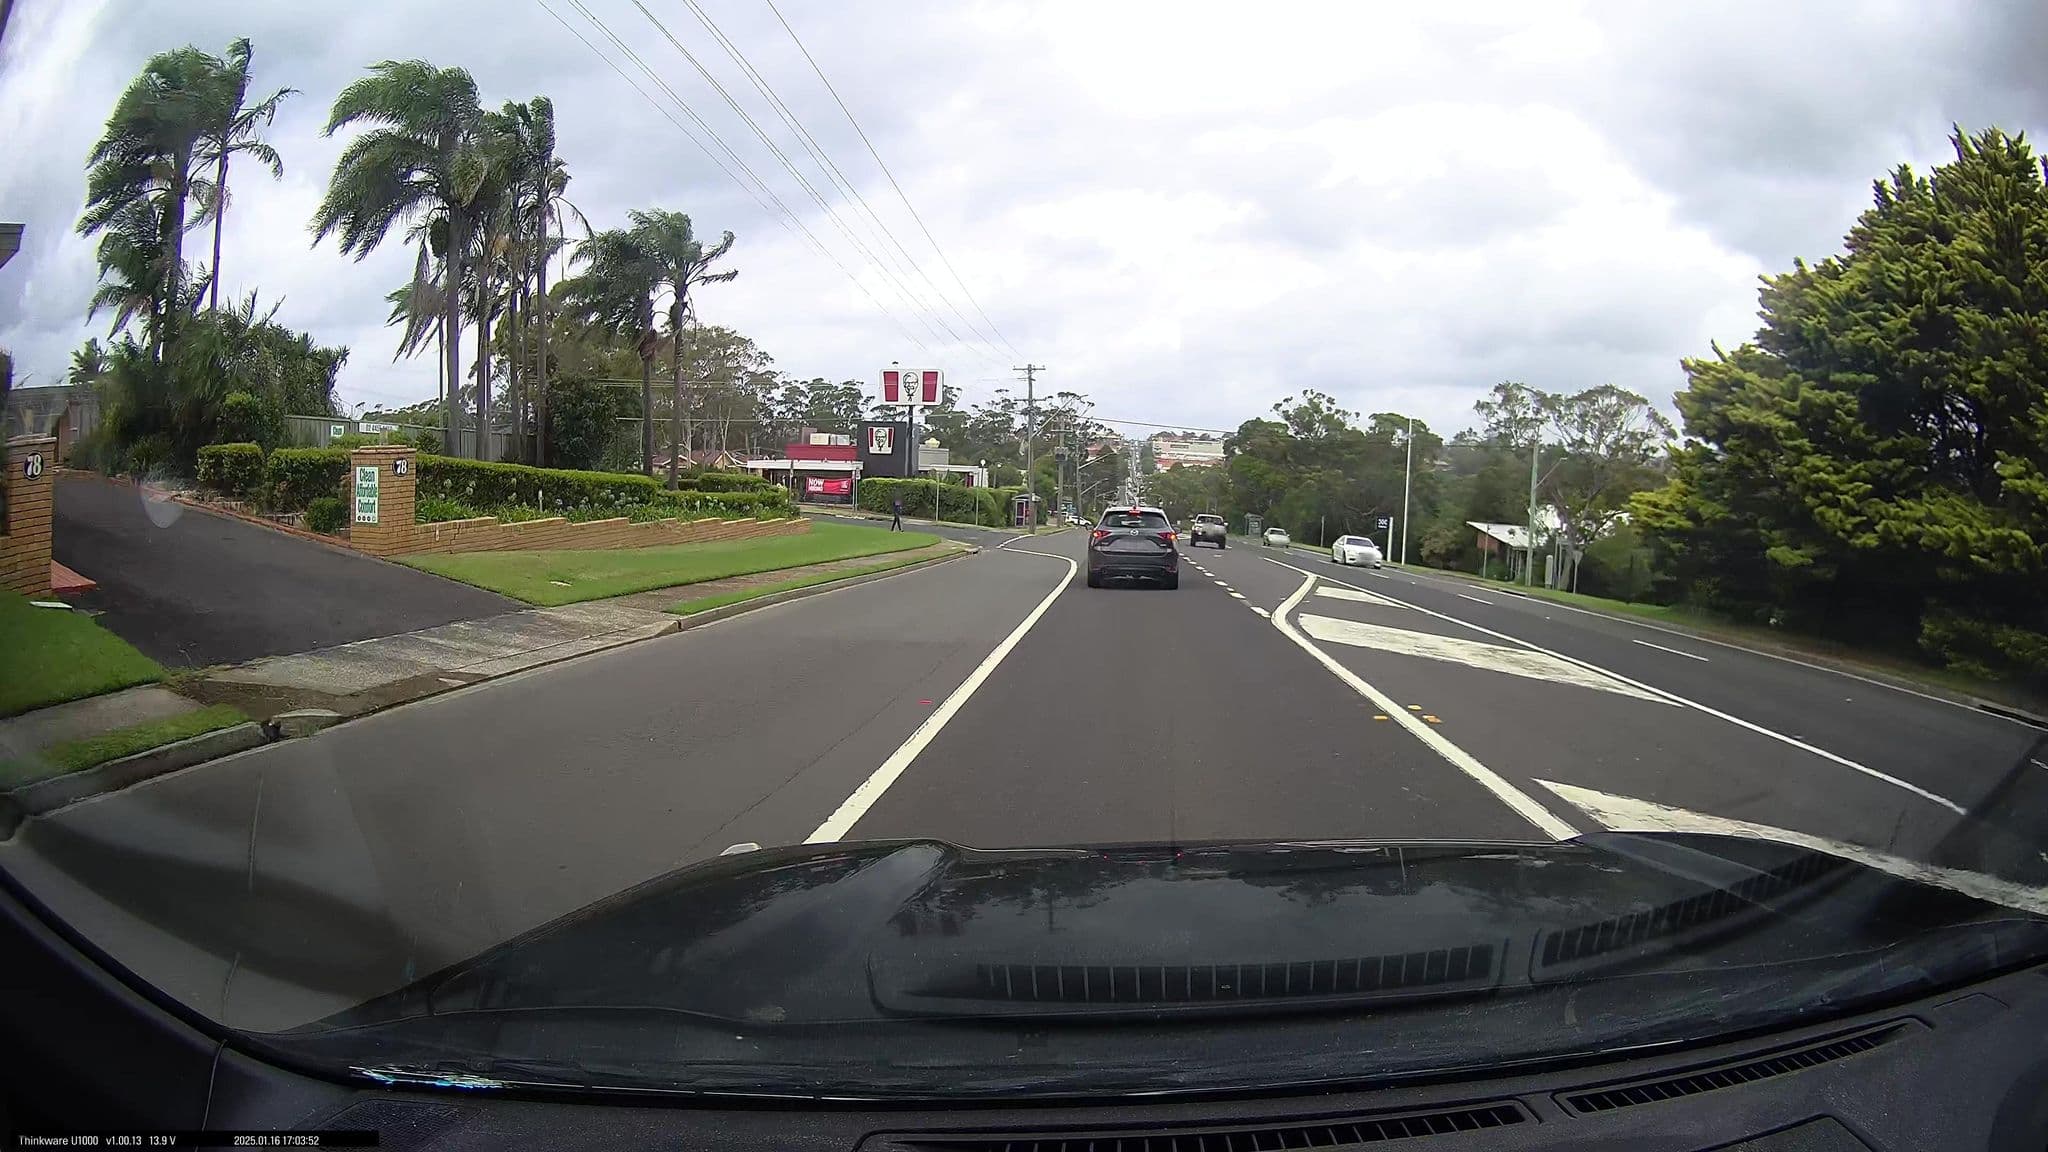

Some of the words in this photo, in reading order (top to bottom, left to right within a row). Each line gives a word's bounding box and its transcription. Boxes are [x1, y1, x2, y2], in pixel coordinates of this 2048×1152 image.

[27, 454, 42, 476] 78
[396, 459, 408, 474] 78
[360, 468, 375, 482] Clean
[808, 477, 824, 486] NOW
[357, 483, 377, 497] Affordable
[358, 499, 375, 513] Comfort
